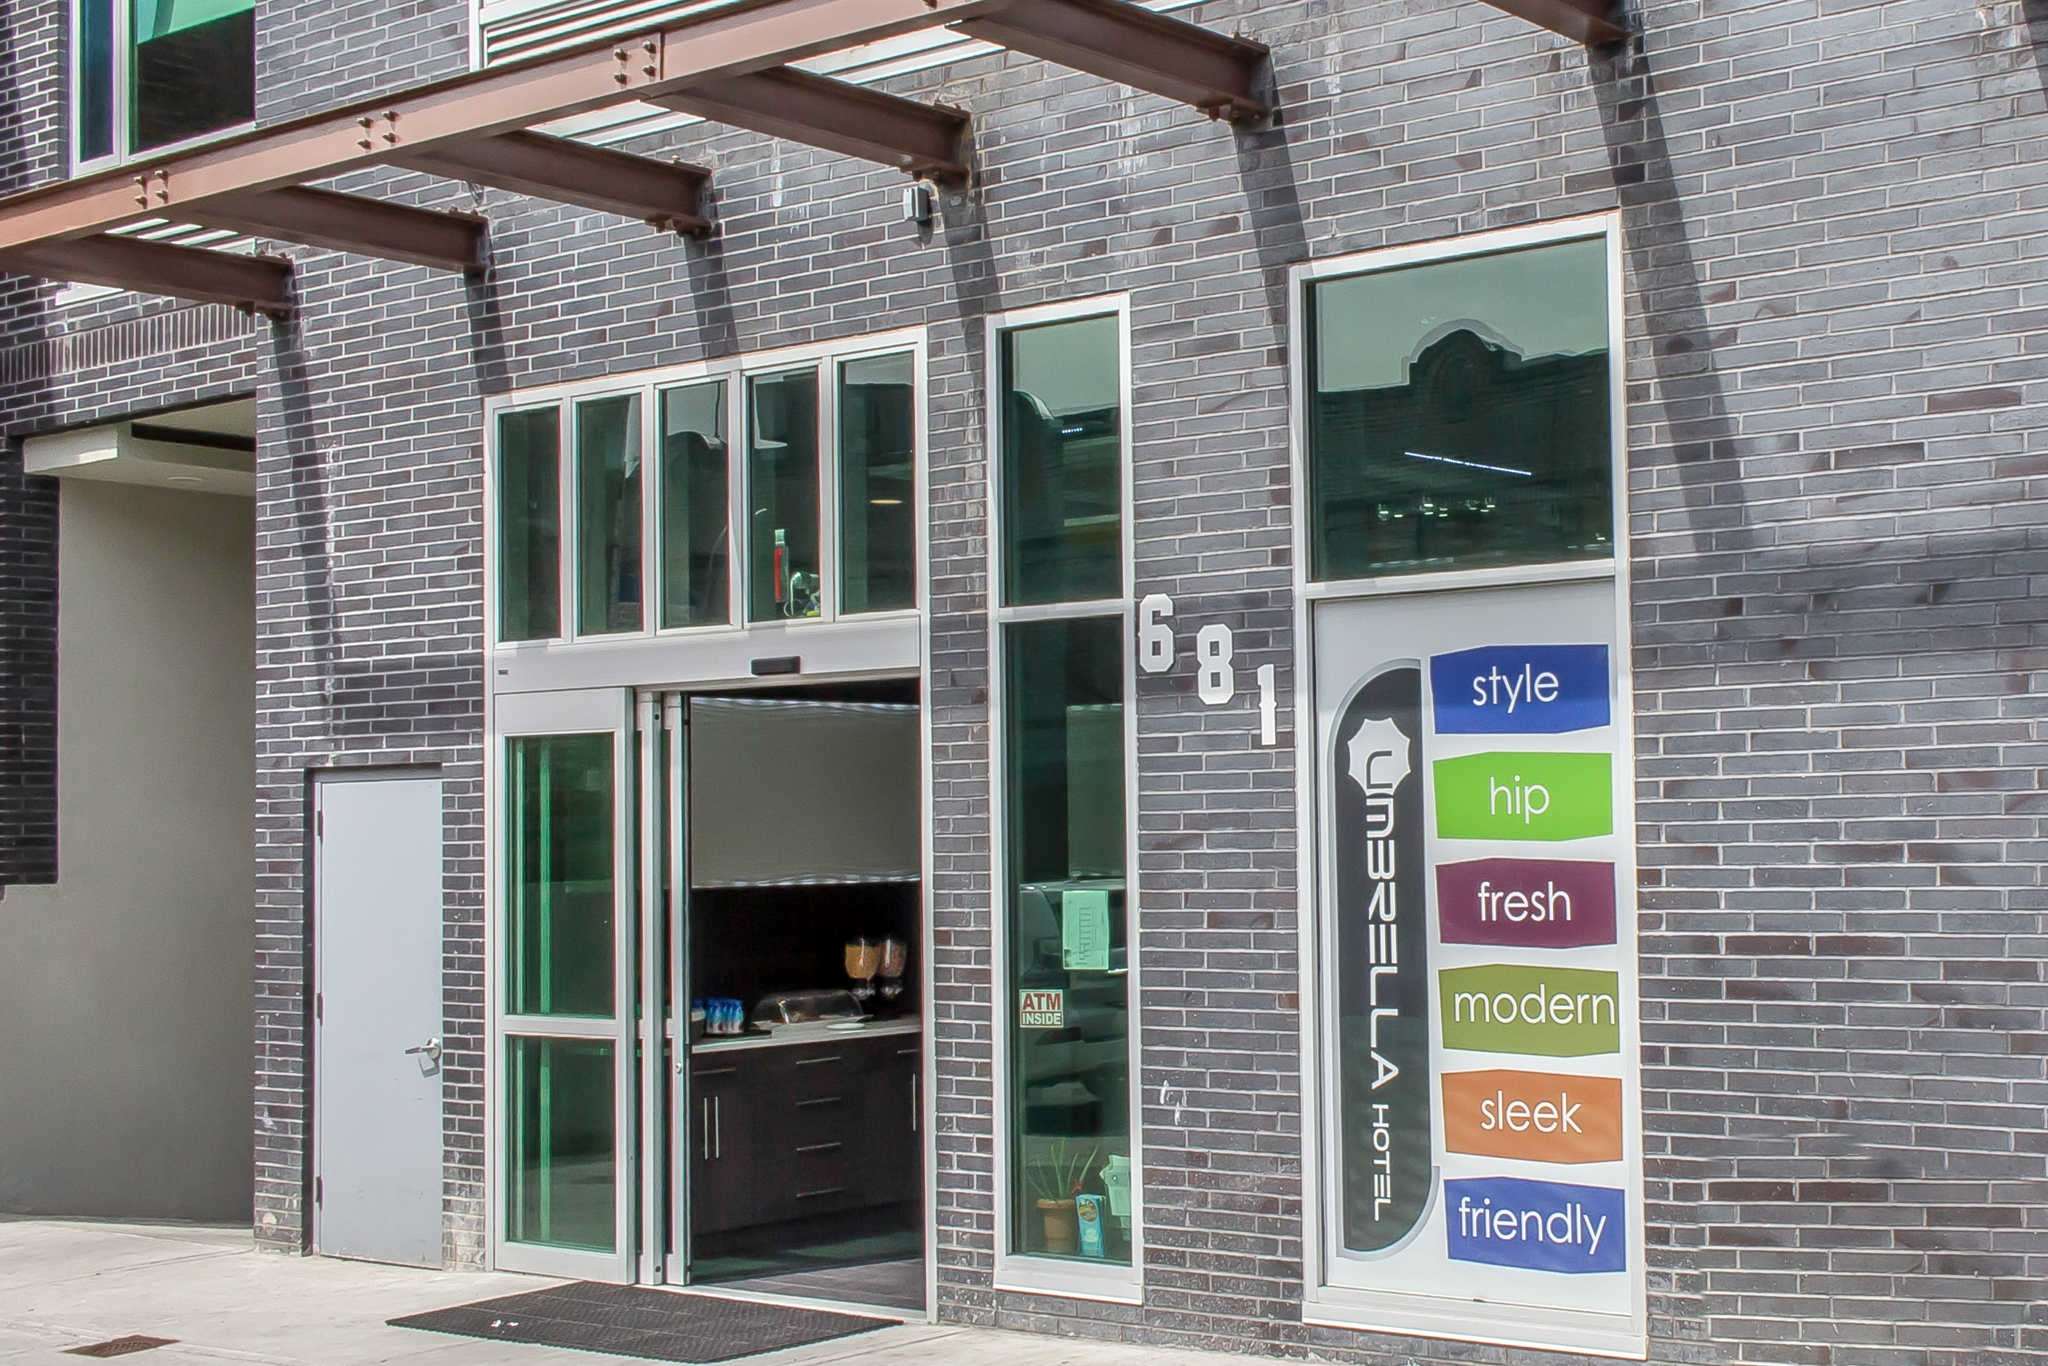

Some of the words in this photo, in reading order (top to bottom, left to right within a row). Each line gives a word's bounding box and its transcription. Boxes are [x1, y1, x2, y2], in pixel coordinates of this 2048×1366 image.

[1139, 593, 1278, 746] 681
[1471, 663, 1560, 714] style
[1489, 775, 1551, 825] hip
[1477, 881, 1571, 922] fresh
[1022, 992, 1061, 1010] ATM
[1022, 1012, 1062, 1025] INSIDE
[1454, 983, 1616, 1025] modern
[1480, 1090, 1583, 1134] sleek
[1371, 1104, 1392, 1222] HOTEL
[1458, 1196, 1607, 1255] friendly
